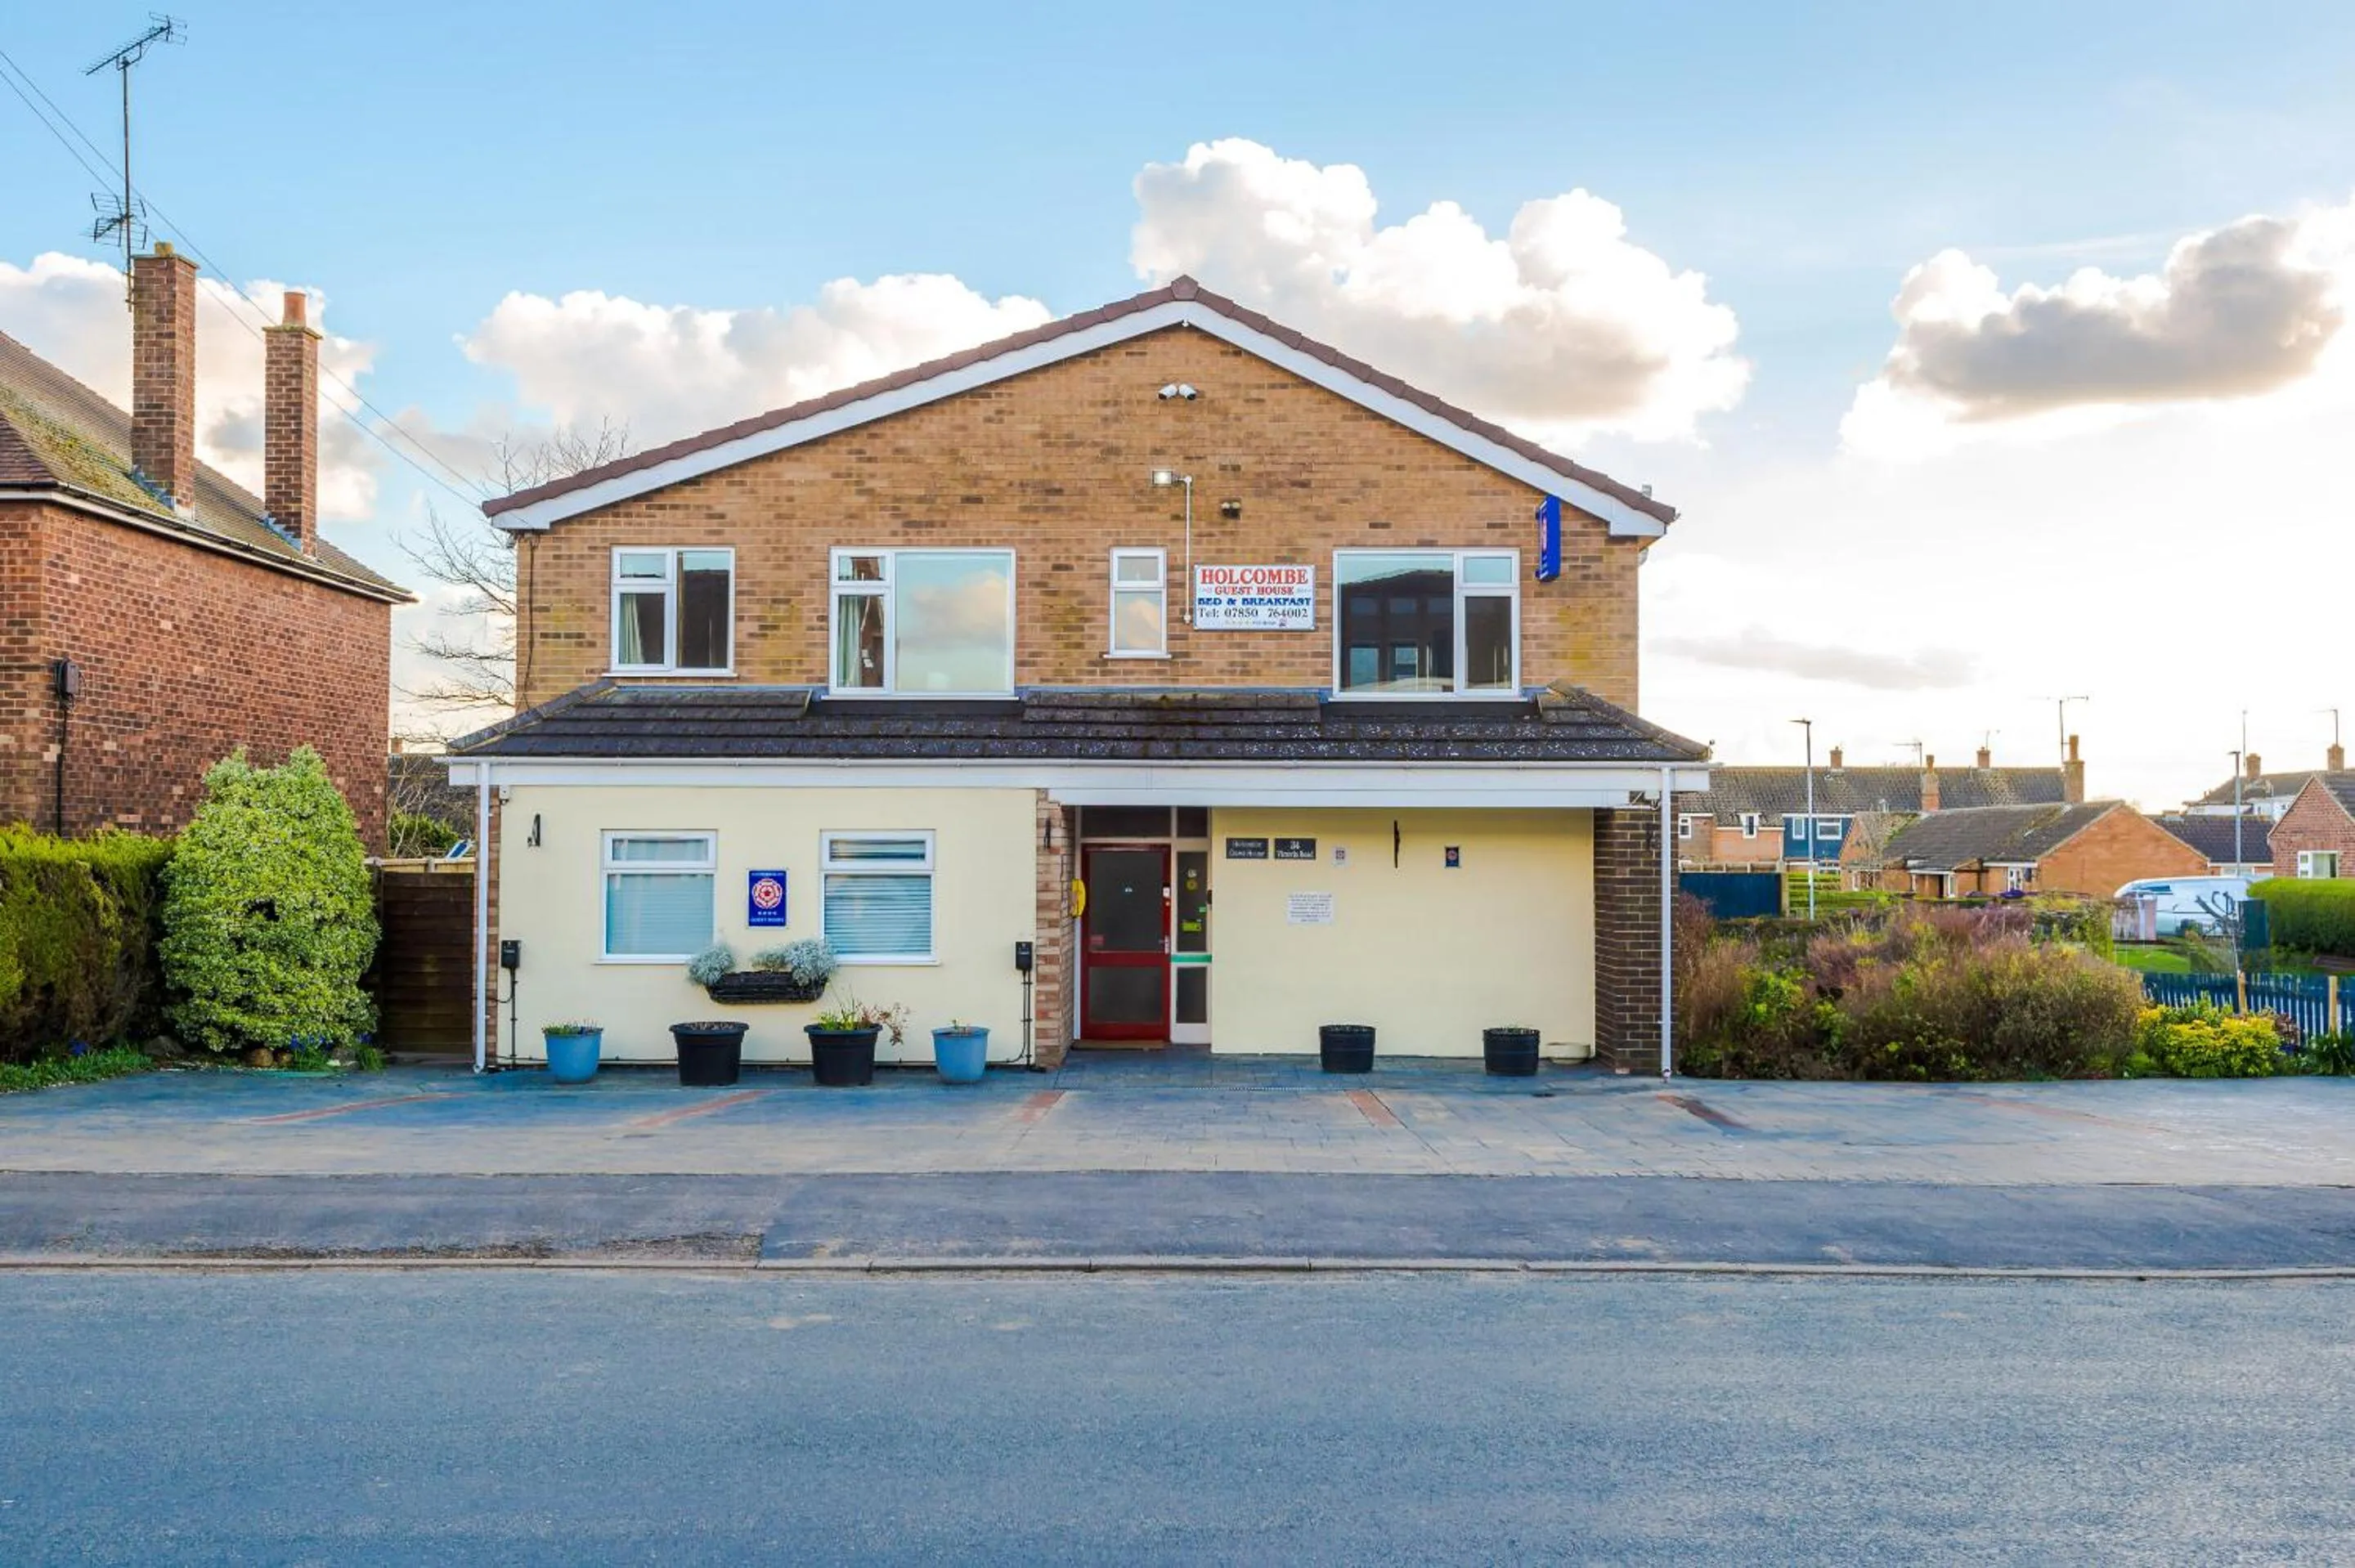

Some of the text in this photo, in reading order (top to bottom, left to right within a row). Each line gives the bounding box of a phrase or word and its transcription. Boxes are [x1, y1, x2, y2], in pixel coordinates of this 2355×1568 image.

[1200, 568, 1308, 585] HOLCOMBE
[1214, 586, 1253, 595] GUEST
[1257, 586, 1294, 595] HOUSE
[1198, 598, 1312, 606] BED & BREAKFAST
[1199, 608, 1219, 618] Tel:
[1224, 608, 1258, 617] 07850
